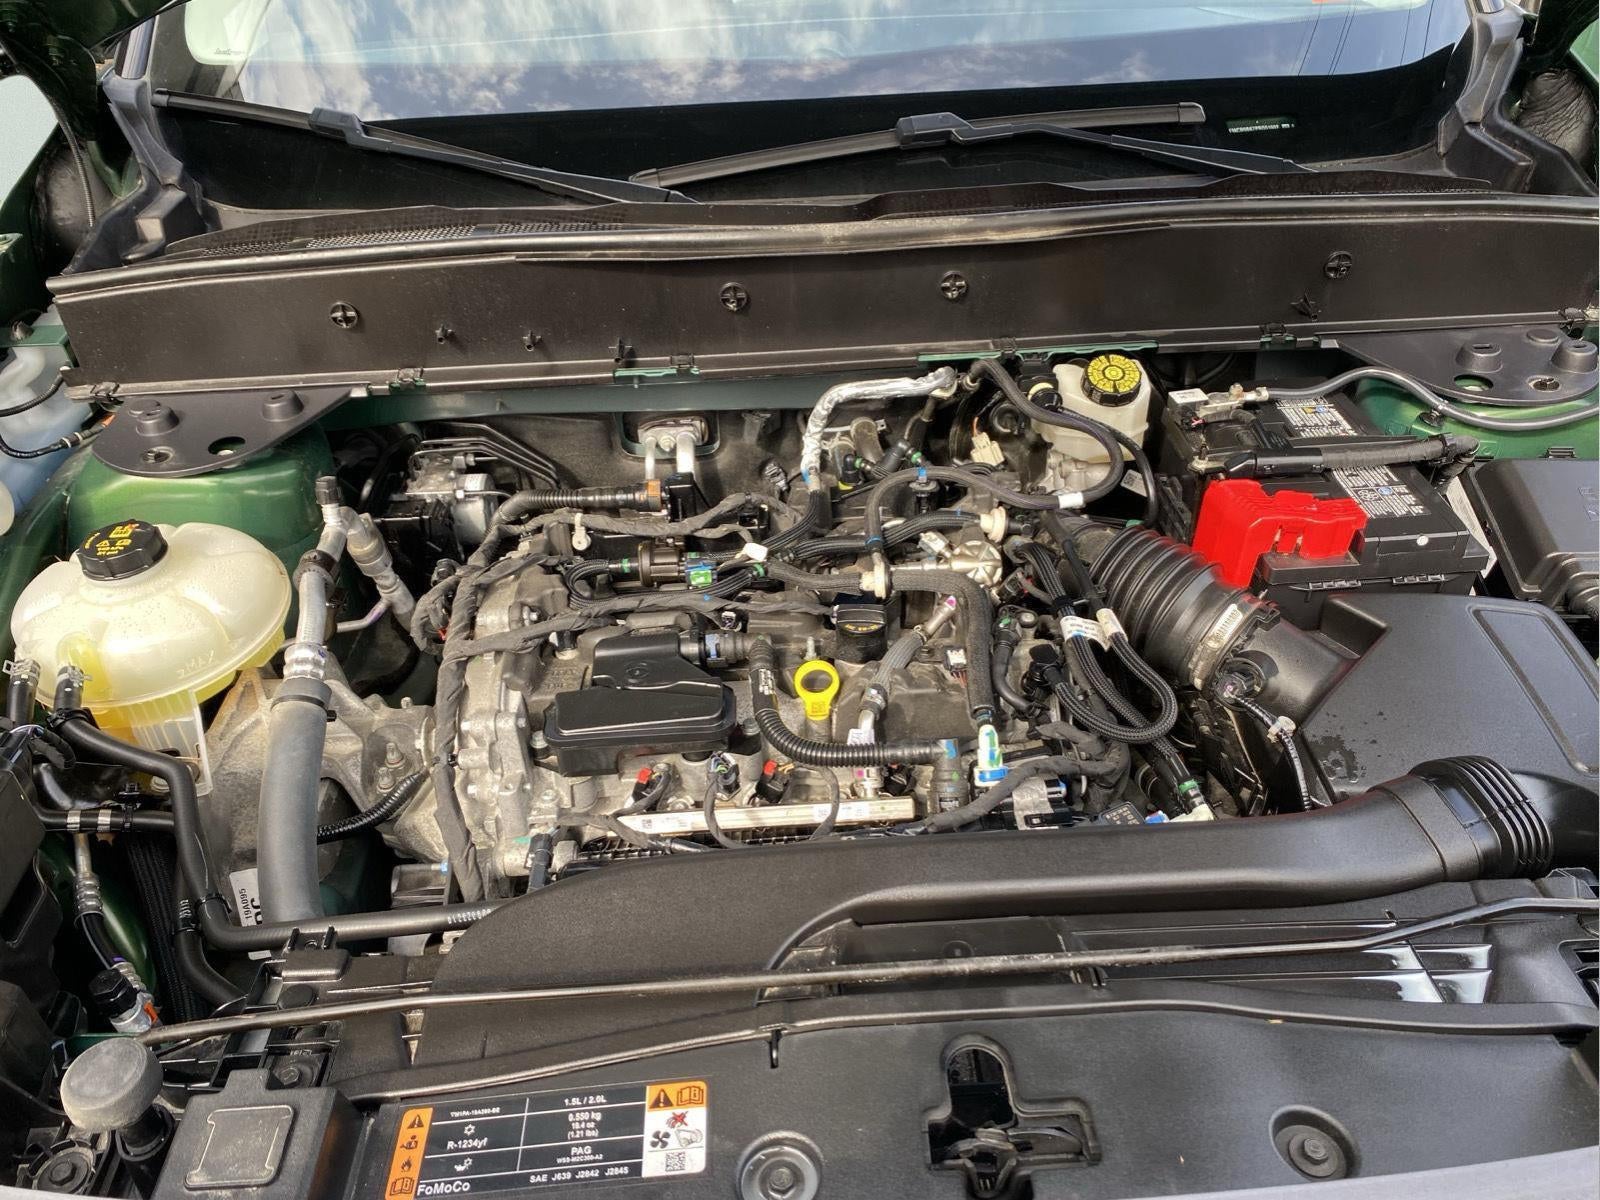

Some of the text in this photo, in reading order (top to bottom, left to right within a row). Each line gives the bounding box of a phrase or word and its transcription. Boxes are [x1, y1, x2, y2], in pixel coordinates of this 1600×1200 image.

[239, 888, 252, 919] 19A095
[564, 1097, 582, 1106] 1.5L
[588, 1095, 607, 1104] 2.0L
[591, 1111, 602, 1121] kg
[446, 1137, 488, 1150] R-1234yf
[571, 1146, 592, 1155] PAG
[529, 1167, 629, 1183] SAE J639 J2842 J2845
[416, 1181, 471, 1196] FoMoCo
